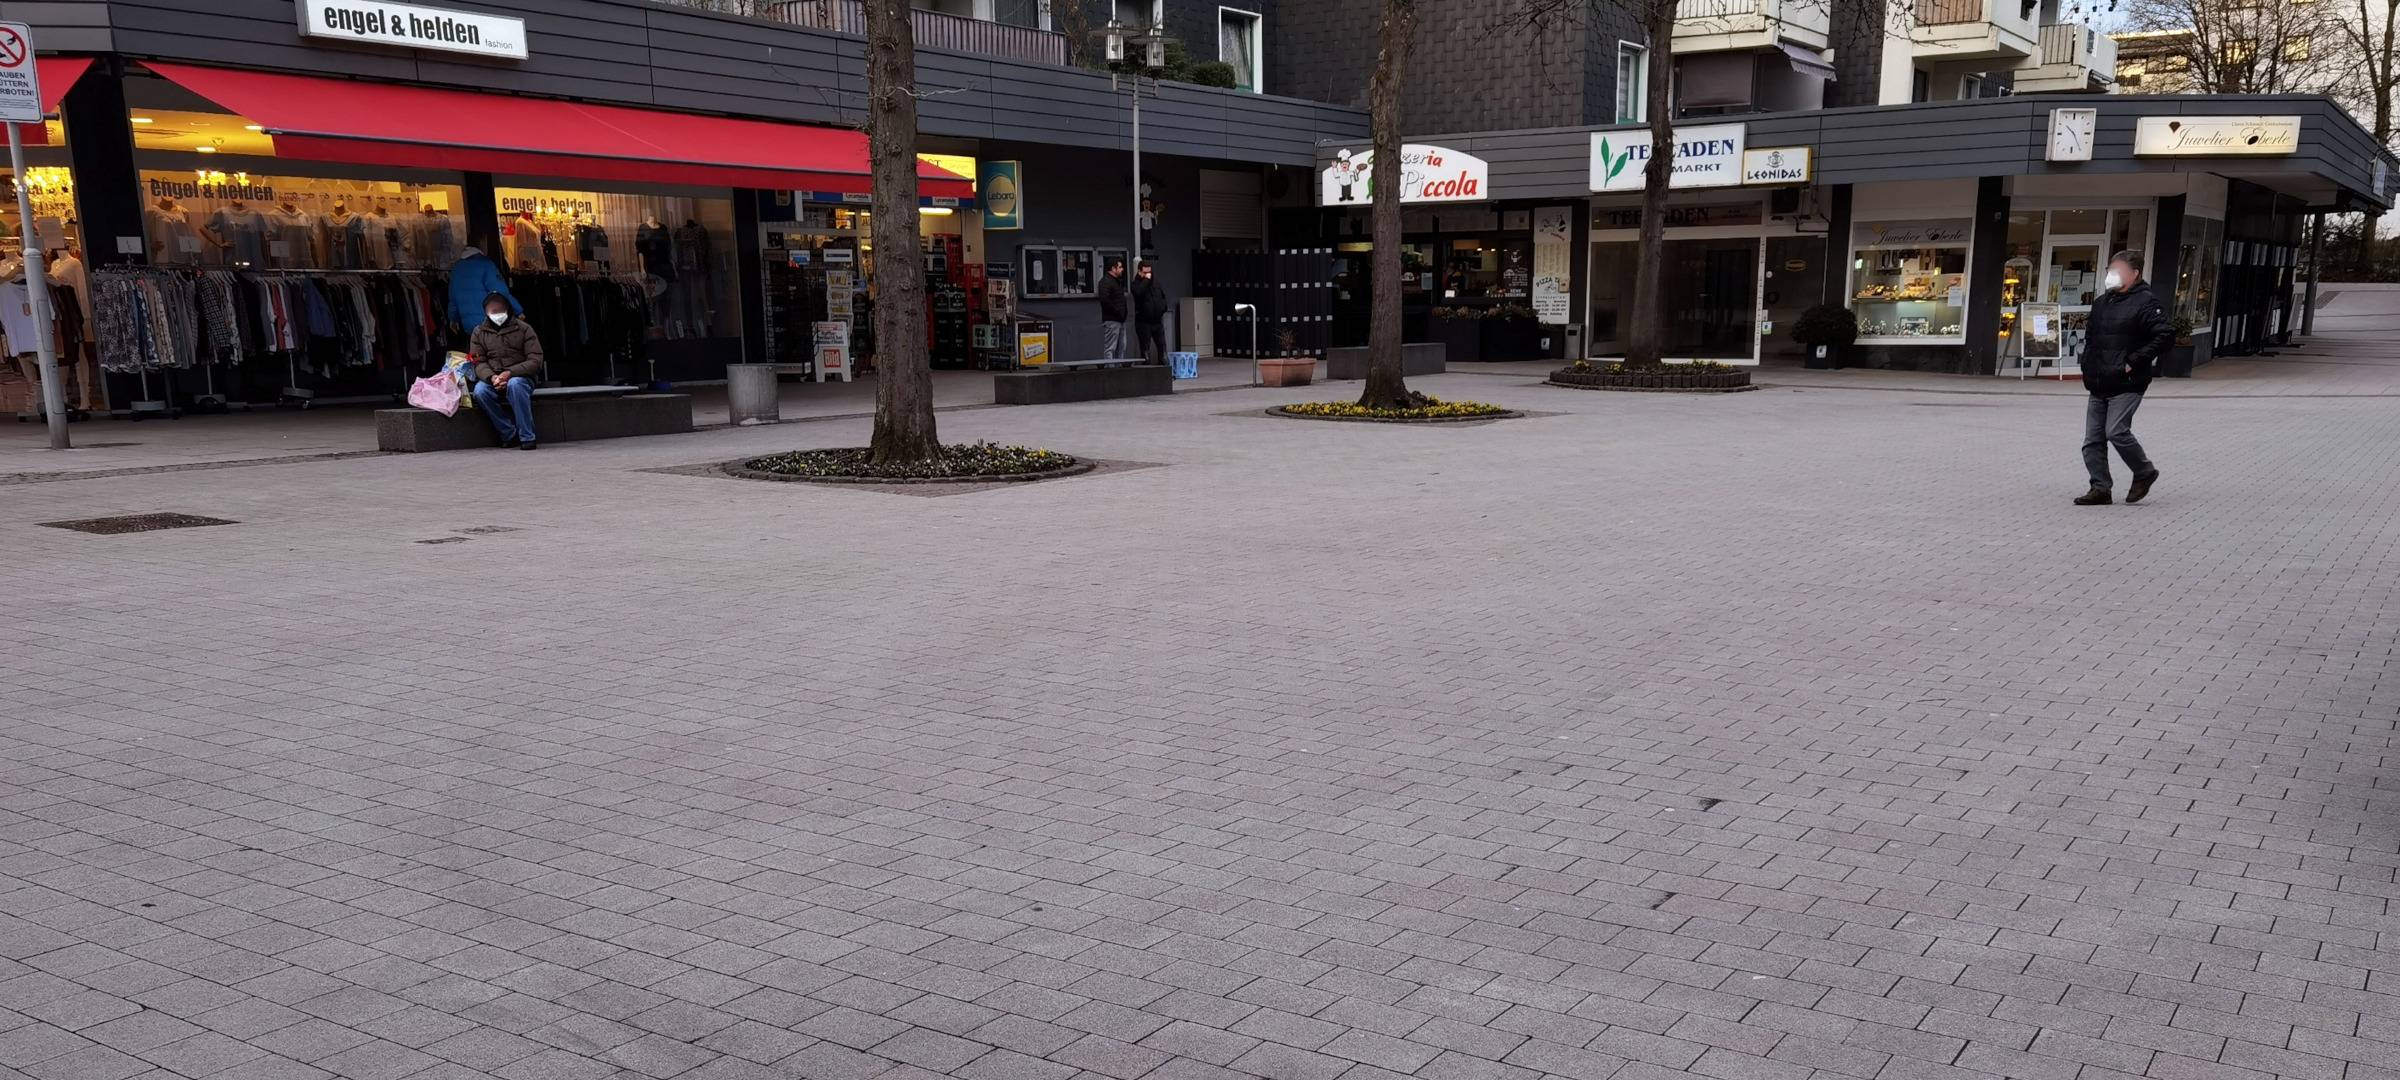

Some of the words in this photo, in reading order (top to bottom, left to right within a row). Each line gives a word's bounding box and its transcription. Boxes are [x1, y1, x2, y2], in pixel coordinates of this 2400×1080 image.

[324, 6, 386, 35] engel
[391, 14, 406, 37] &
[409, 13, 480, 45] helden
[485, 38, 513, 50] fashion
[0, 71, 26, 79] AUBEN
[0, 79, 29, 88] ÜTTERN
[0, 88, 34, 96] RBOTEN!
[2167, 125, 2233, 150] Juwelier
[2240, 126, 2291, 146] Eberle
[1625, 139, 1735, 161] TEADEN
[1747, 168, 1802, 180] LEONIDAS
[151, 179, 199, 200] engel
[202, 185, 214, 199] &
[217, 181, 274, 201] helden
[1400, 170, 1478, 199] Piccola
[502, 196, 537, 213] engel
